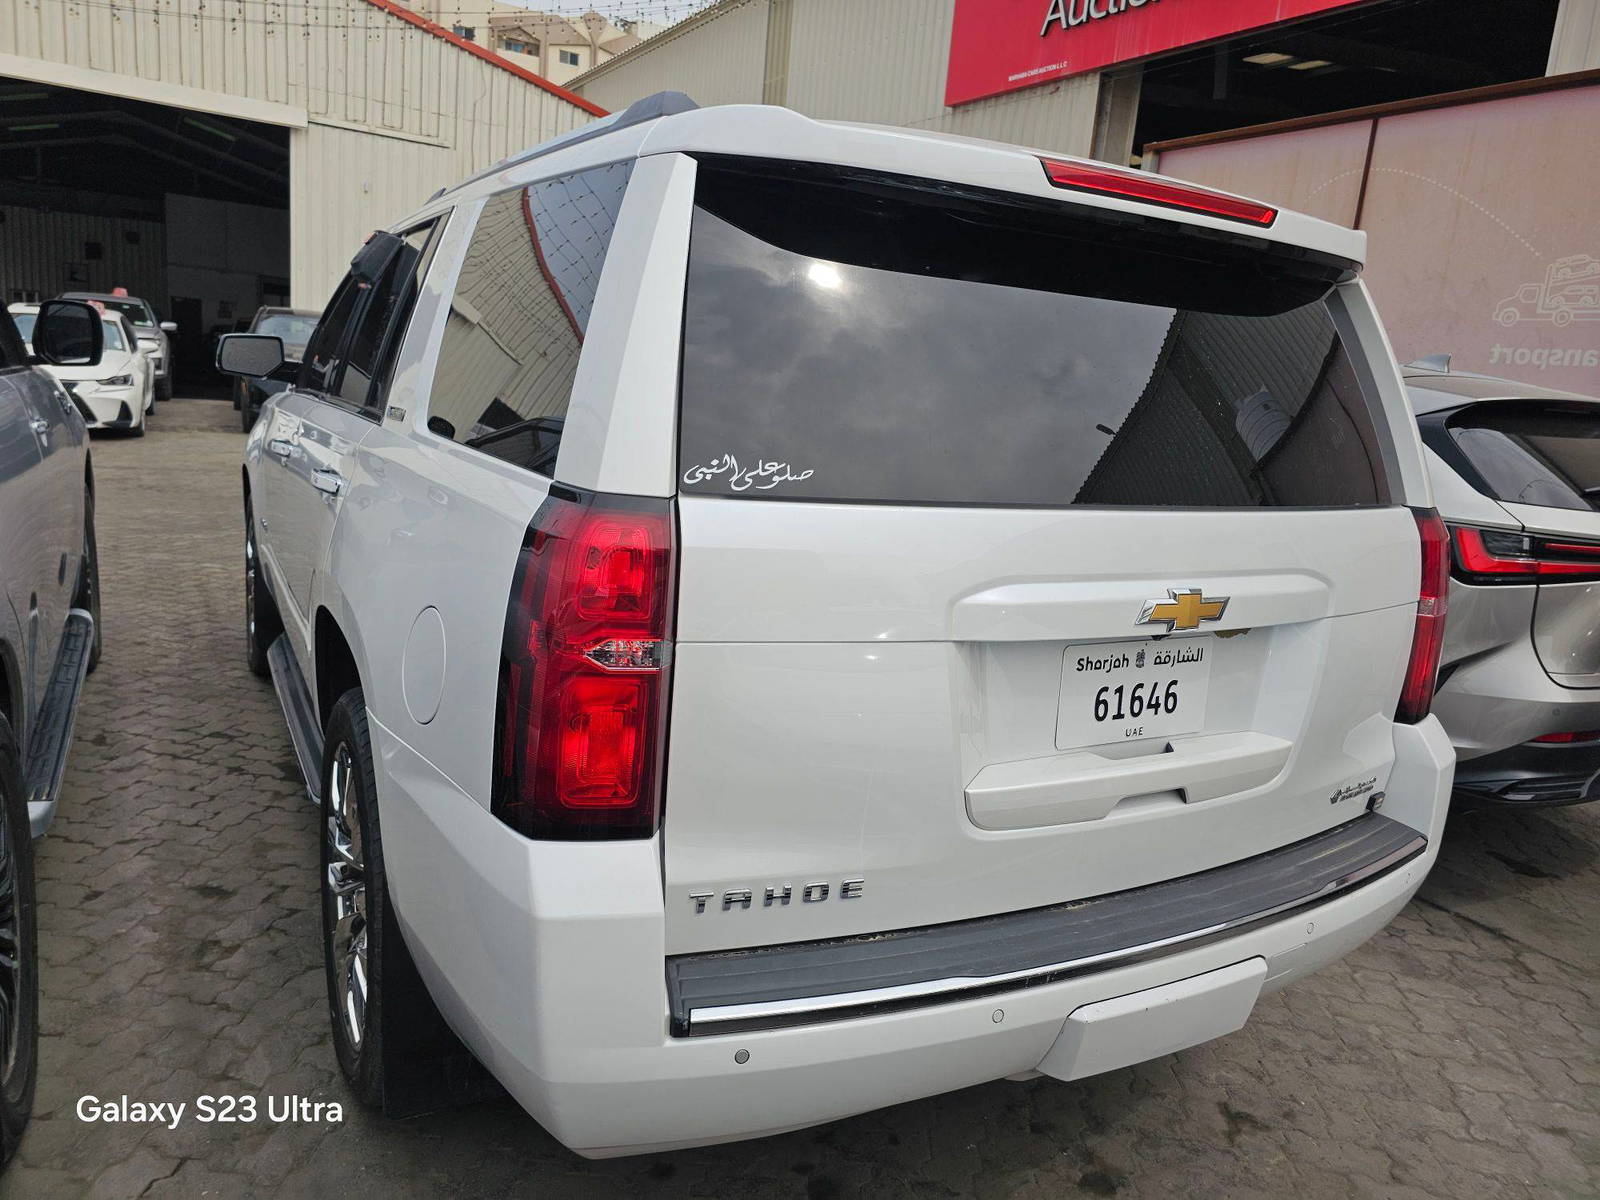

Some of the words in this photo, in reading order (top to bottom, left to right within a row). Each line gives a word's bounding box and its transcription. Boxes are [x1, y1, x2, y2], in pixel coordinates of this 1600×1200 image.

[1076, 653, 1130, 673] Sharjah
[1153, 646, 1204, 667] الشارقة
[1094, 679, 1179, 722] 61646
[1125, 726, 1144, 737] UAE
[688, 877, 865, 914] TAHOE
